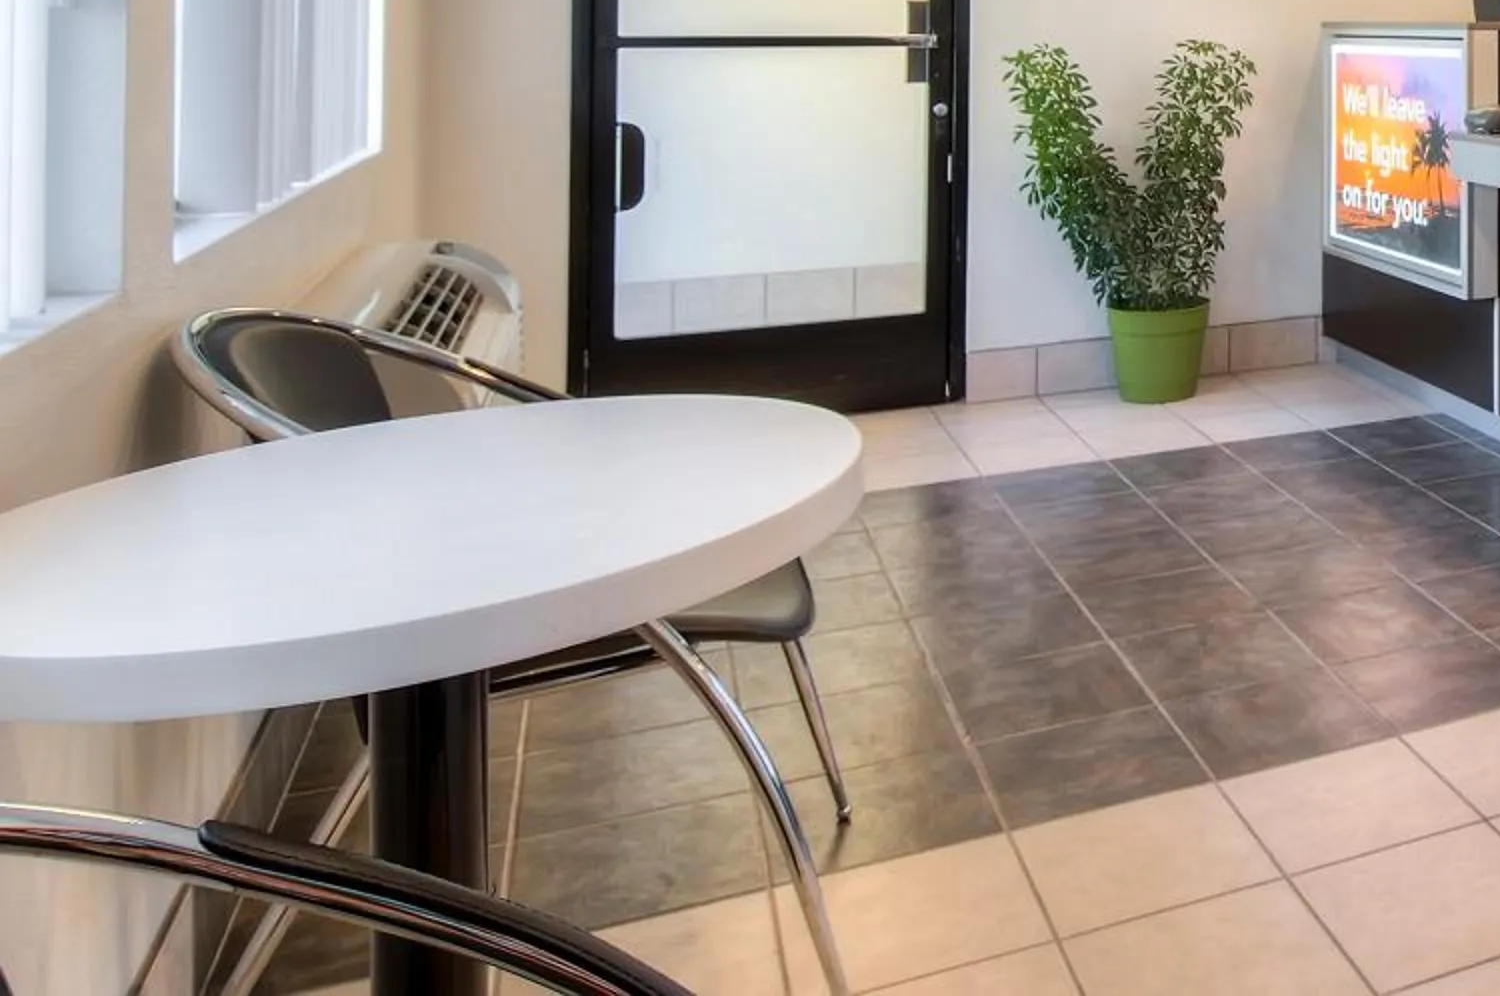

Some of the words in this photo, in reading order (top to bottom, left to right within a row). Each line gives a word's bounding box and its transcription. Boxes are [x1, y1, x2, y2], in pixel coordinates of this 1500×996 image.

[1342, 82, 1379, 117] We'll
[1383, 86, 1426, 123] leave
[1342, 129, 1367, 163] the
[1371, 132, 1409, 177] light
[1342, 183, 1362, 209] on
[1364, 177, 1388, 215] for
